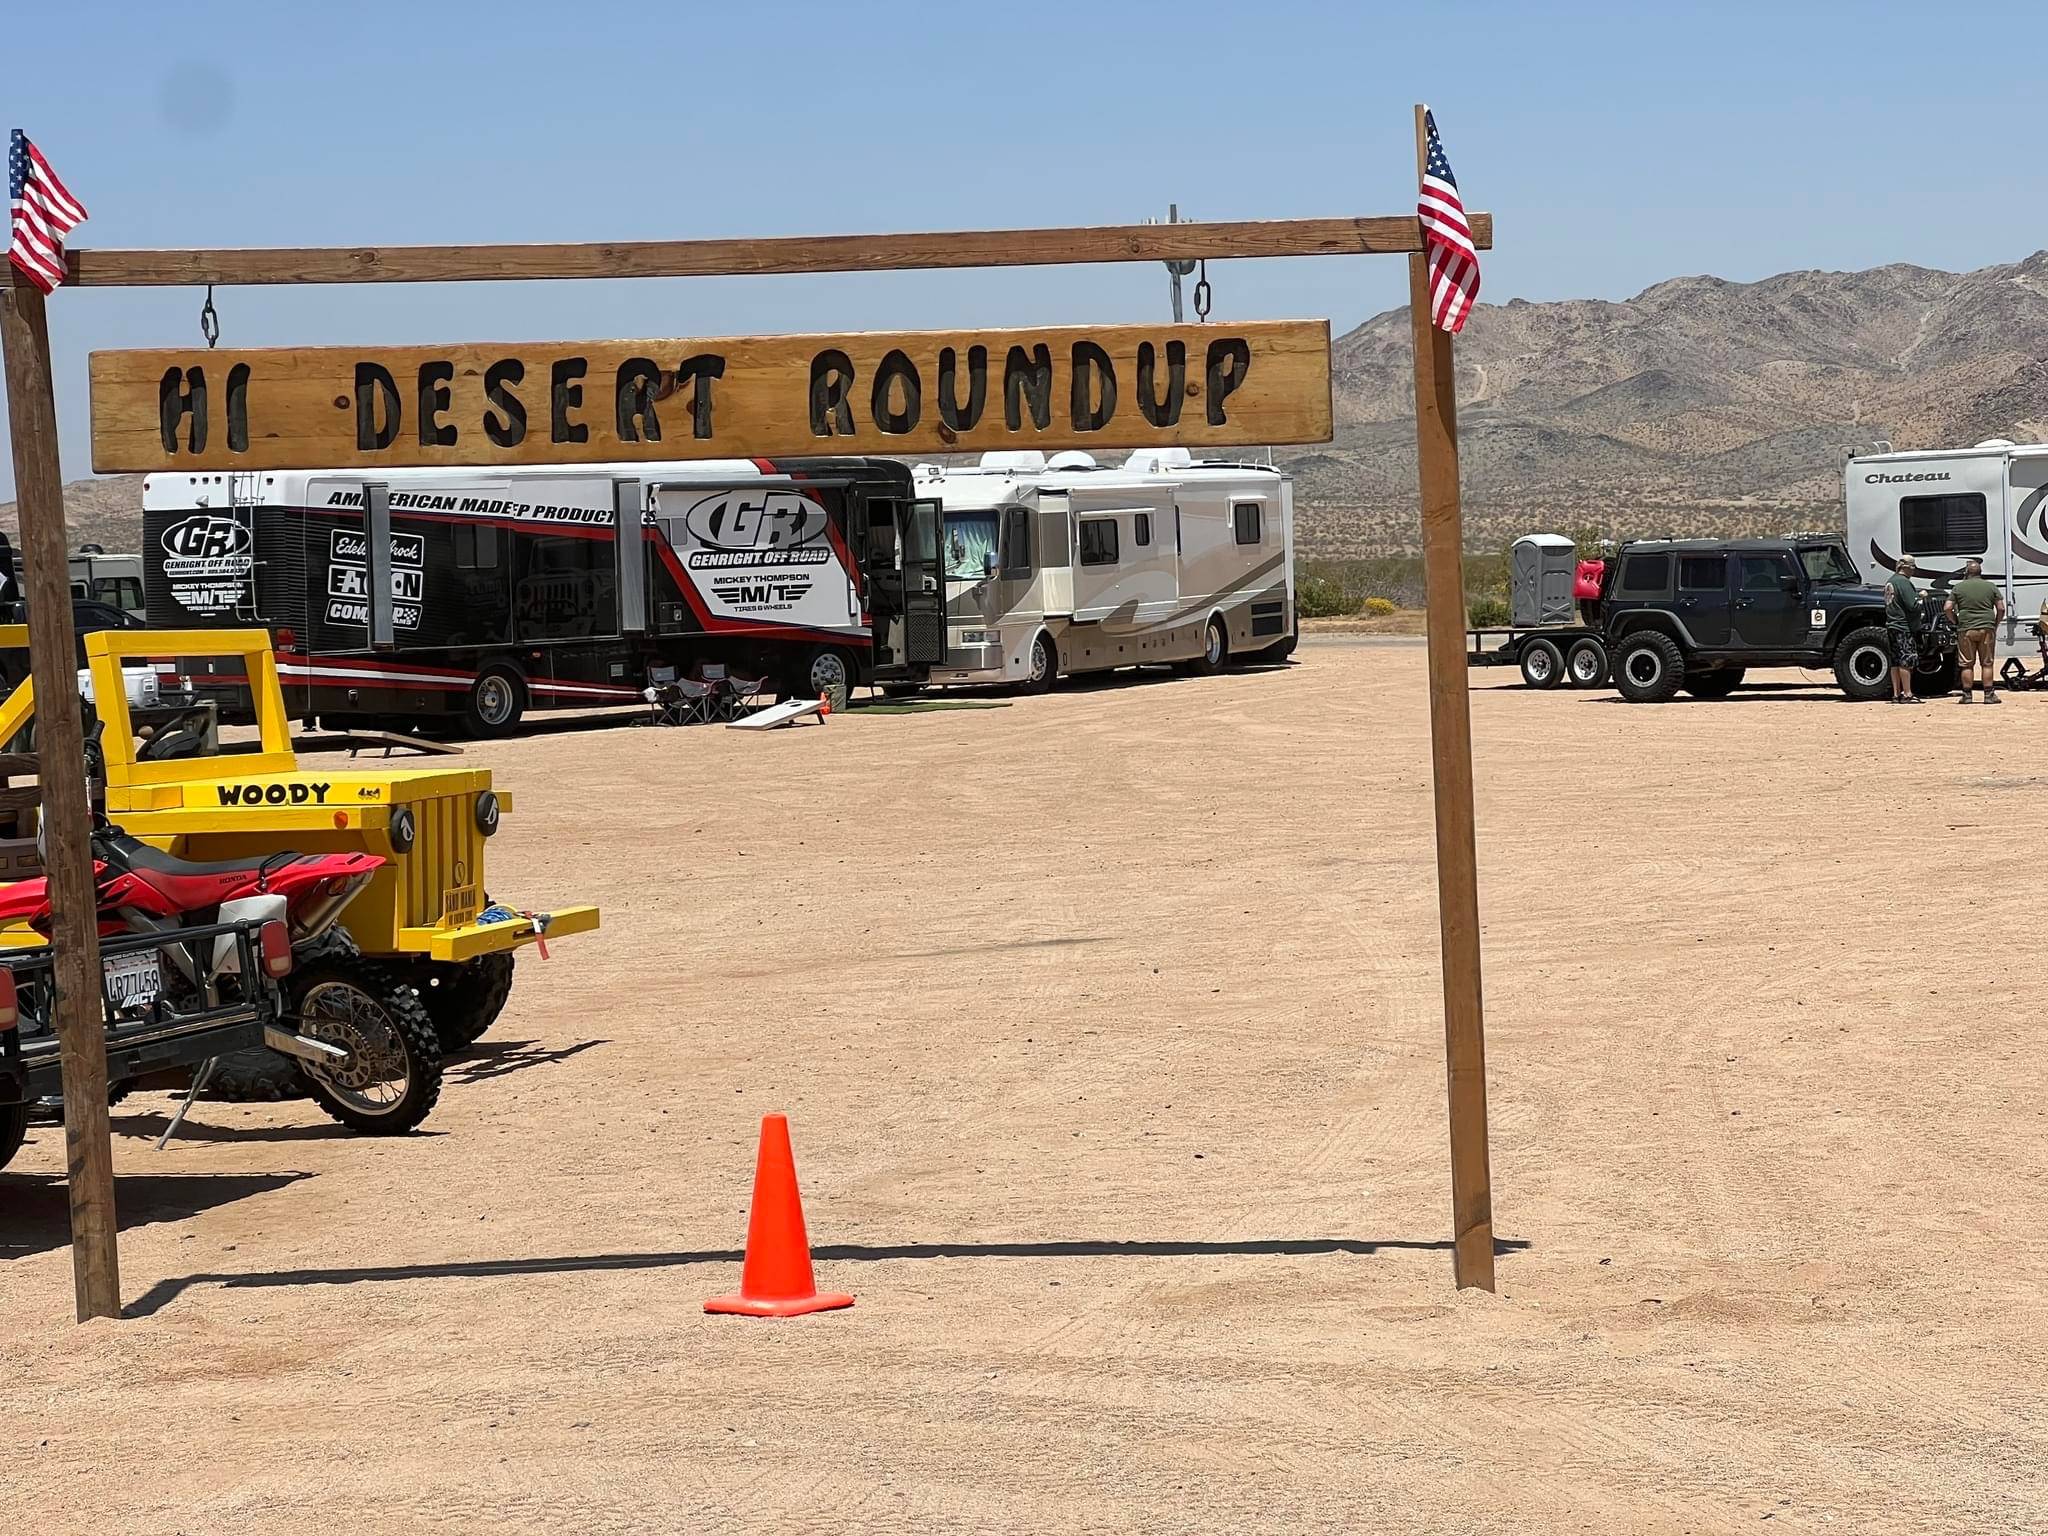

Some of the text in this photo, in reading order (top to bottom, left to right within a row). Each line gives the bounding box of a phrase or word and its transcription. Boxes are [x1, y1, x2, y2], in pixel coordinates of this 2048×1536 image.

[158, 337, 1250, 455] HI DESERT ROUNDUP
[1864, 471, 1951, 484] Chateau
[459, 497, 513, 514] MADE
[164, 559, 206, 569] GENRIGHT
[207, 558, 224, 568] OFF
[690, 550, 828, 567] GENRIGHT OFF ROAD
[713, 574, 810, 584] MICKEY THOMPSON
[740, 584, 790, 603] M/T
[217, 783, 331, 805] WOODY
[219, 874, 247, 884] HONDA
